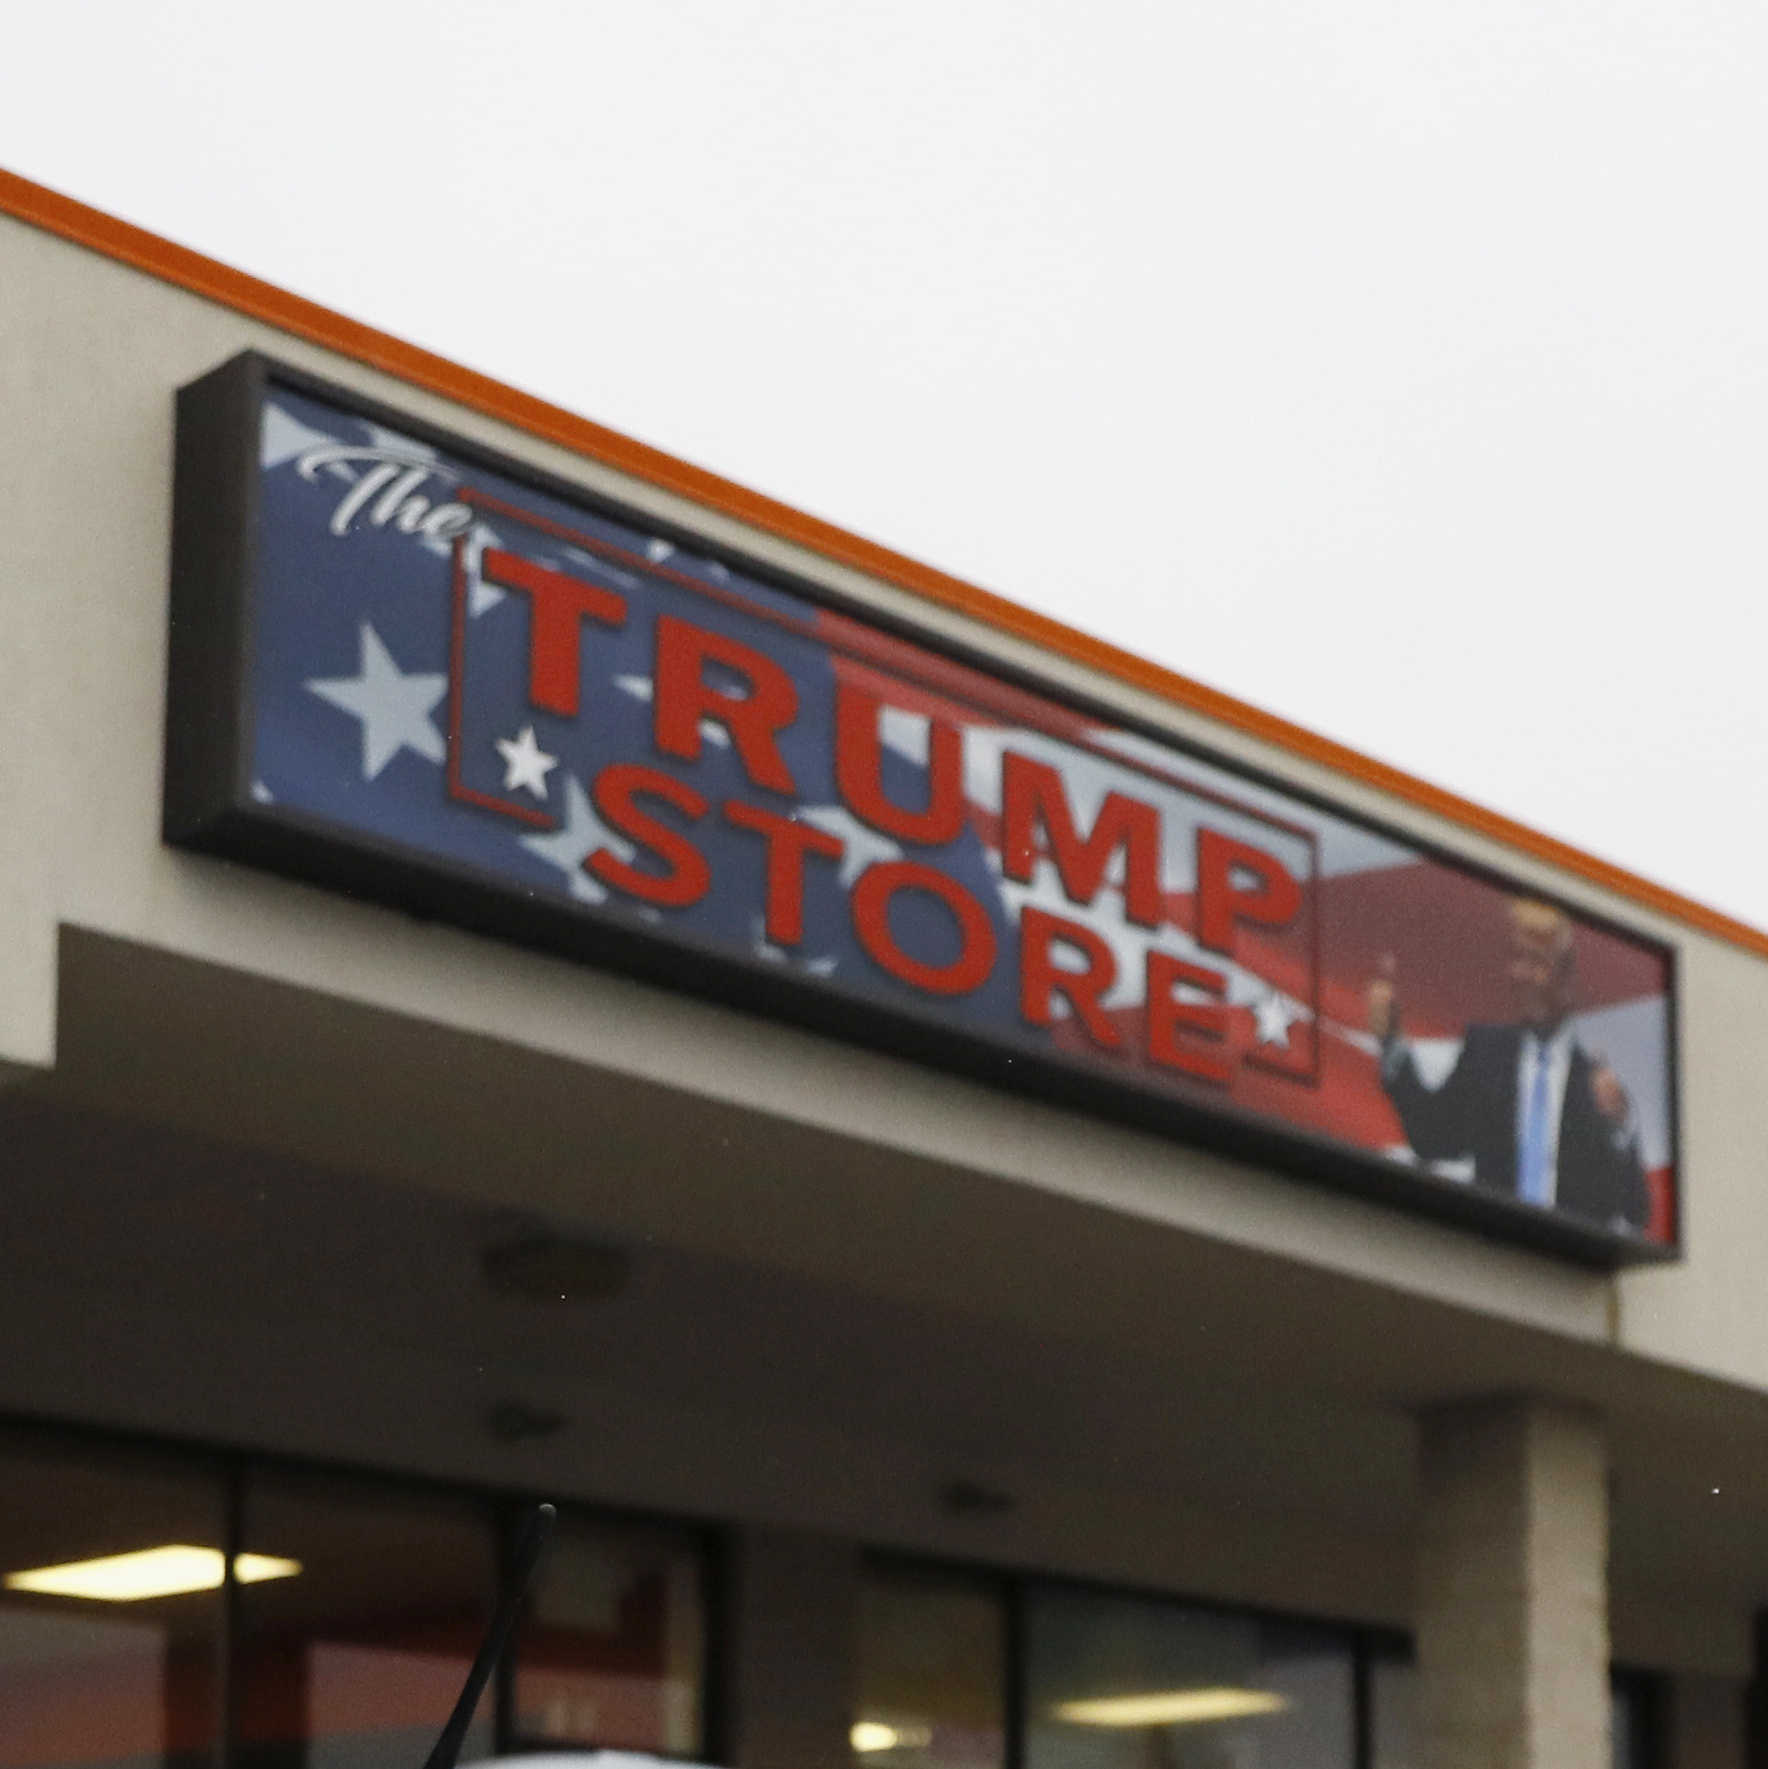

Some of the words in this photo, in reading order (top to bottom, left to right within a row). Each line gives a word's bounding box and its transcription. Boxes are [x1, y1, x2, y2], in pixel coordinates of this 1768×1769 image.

[297, 444, 473, 537] The
[480, 545, 1304, 956] TRUMP
[581, 762, 1235, 1086] STORE
